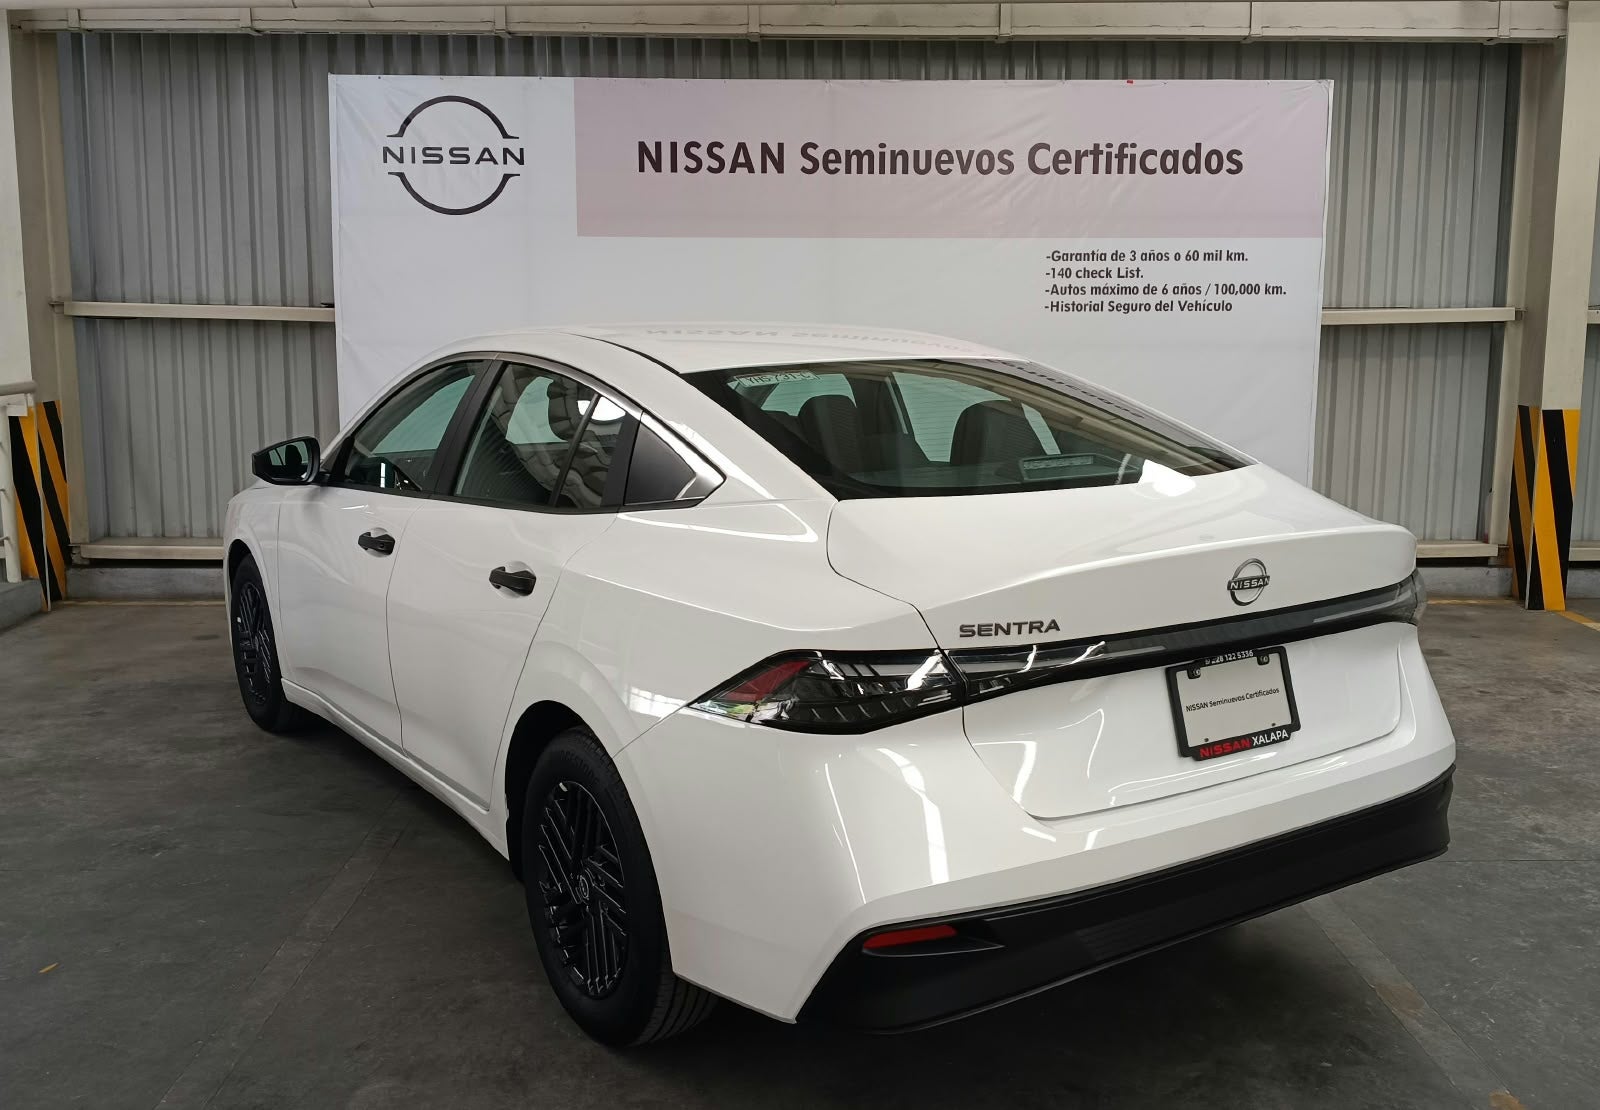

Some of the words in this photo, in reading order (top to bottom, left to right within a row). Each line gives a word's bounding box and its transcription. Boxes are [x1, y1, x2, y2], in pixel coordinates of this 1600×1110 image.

[382, 146, 525, 166] NISSAN
[637, 140, 785, 175] NISSAN
[799, 141, 1015, 176] Seminuevos
[1027, 142, 1244, 176] Certificados
[1045, 248, 1107, 262] -Garantía
[1110, 249, 1126, 262] de
[1129, 249, 1137, 262] 3
[1140, 249, 1170, 262] años
[1173, 251, 1182, 262] o
[1185, 249, 1200, 262] 60
[1202, 249, 1223, 262] mil
[1225, 249, 1249, 262] km.
[1045, 267, 1073, 279] -140
[1075, 266, 1113, 279] check
[1117, 266, 1144, 279] List.
[1044, 283, 1087, 296] -Autos
[1090, 282, 1140, 296] máximo
[1142, 283, 1158, 296] de
[1161, 283, 1169, 296] 6
[1172, 282, 1202, 296] años
[1204, 283, 1212, 297] /
[1214, 283, 1261, 296] 100,000
[1264, 282, 1287, 295] km.
[1044, 300, 1104, 313] -Historial
[1107, 300, 1152, 315] Seguro
[1154, 299, 1174, 312] del
[1177, 299, 1233, 312] Vehículo
[1229, 576, 1270, 590] NISSAN
[959, 618, 1061, 638] SENTRA
[1185, 702, 1209, 712] NISSAN
[1209, 695, 1246, 707] Seminuevos
[1246, 687, 1279, 700] Certificados
[1200, 738, 1251, 758] NISSAN
[1251, 729, 1289, 746] XALAPA
